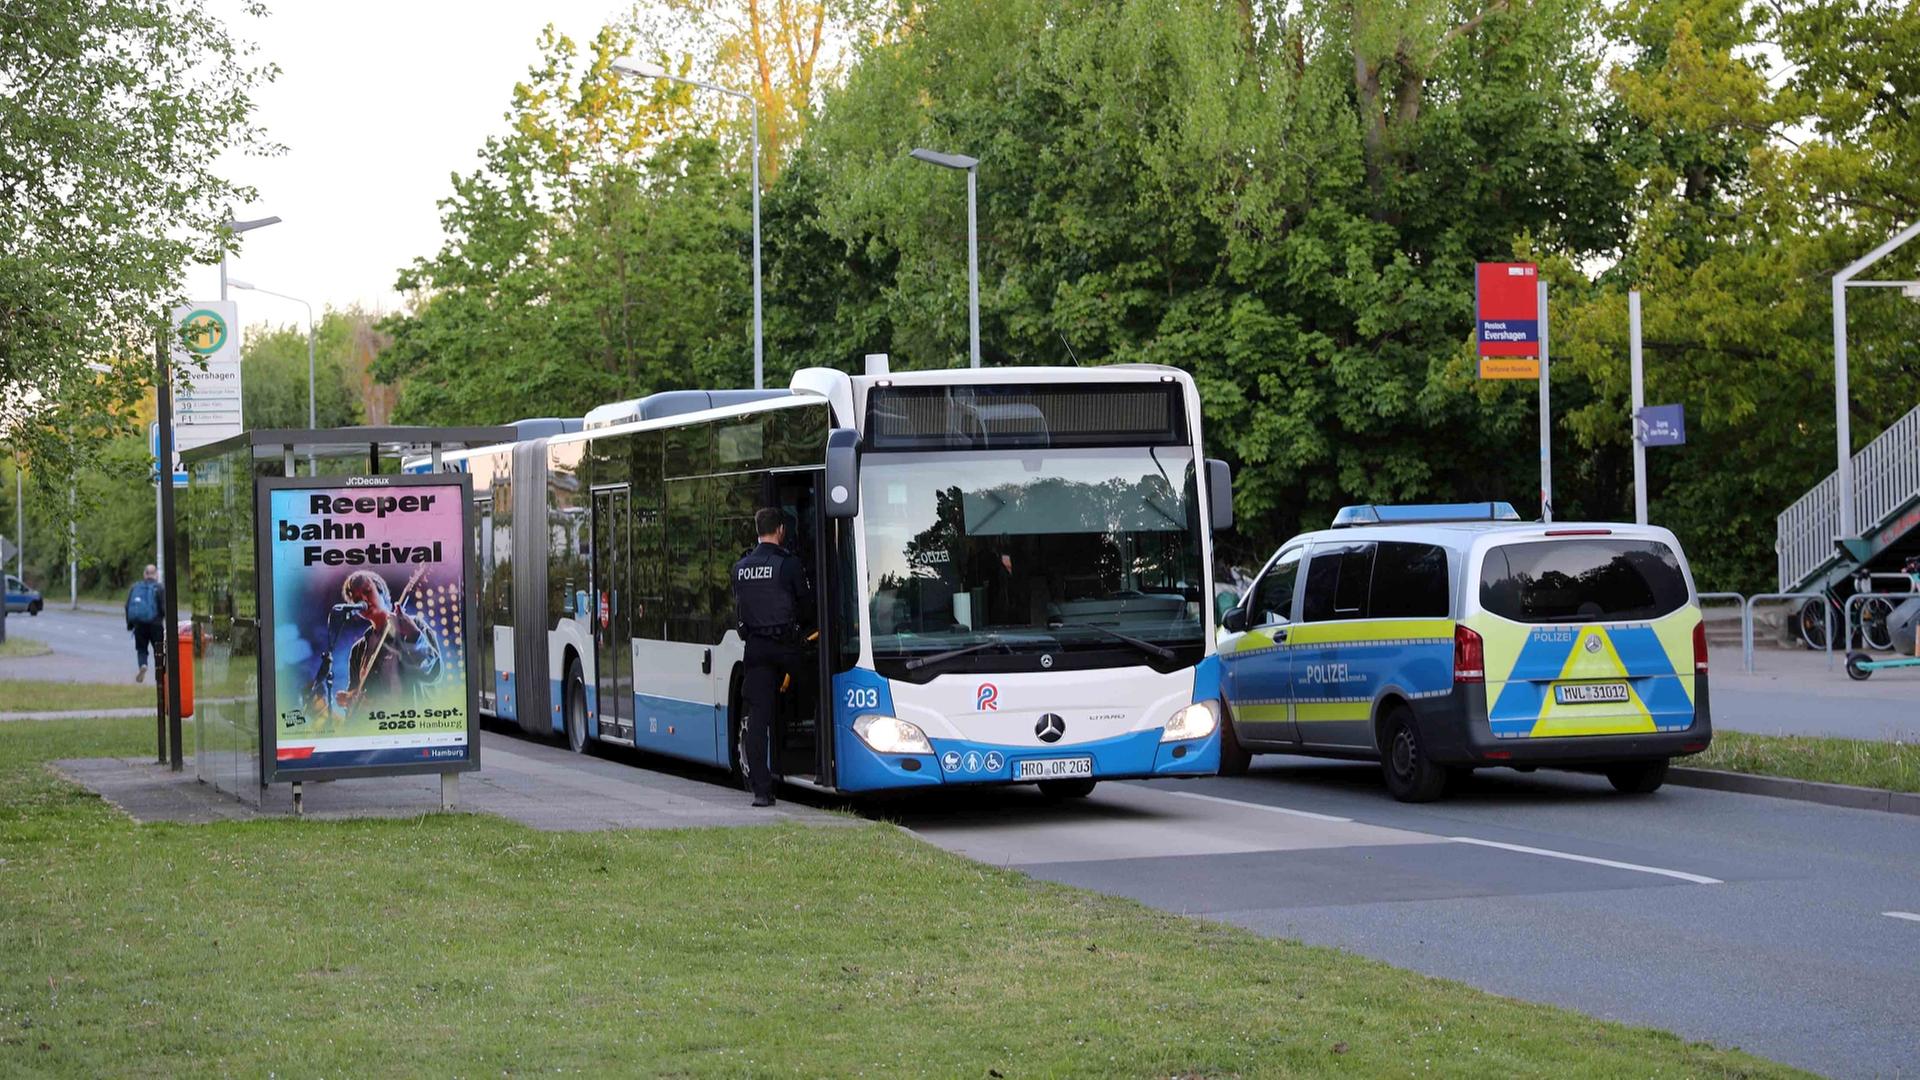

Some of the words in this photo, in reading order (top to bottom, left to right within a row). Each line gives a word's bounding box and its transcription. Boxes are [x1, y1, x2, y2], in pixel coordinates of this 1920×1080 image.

[1484, 330, 1527, 341] Evershagen
[181, 402, 192, 410] 39
[181, 415, 192, 423] F1
[346, 477, 389, 486] JCDecaux
[310, 494, 435, 518] Reeper
[279, 519, 365, 542] bahn
[303, 541, 442, 567] Festival
[915, 550, 951, 564] OLIZEI
[738, 566, 773, 581] POLIZEI
[1534, 632, 1572, 642] POLIZEI
[847, 688, 878, 708] 203
[1564, 687, 1586, 700] MVL
[1592, 685, 1626, 699] 31012
[423, 707, 463, 719] Sept.
[378, 720, 416, 731] 2026
[419, 719, 463, 729] Hamburg
[431, 748, 464, 758] Hamburg
[1021, 762, 1044, 776] HRO
[1051, 761, 1067, 775] OR
[1069, 759, 1090, 774] 203
